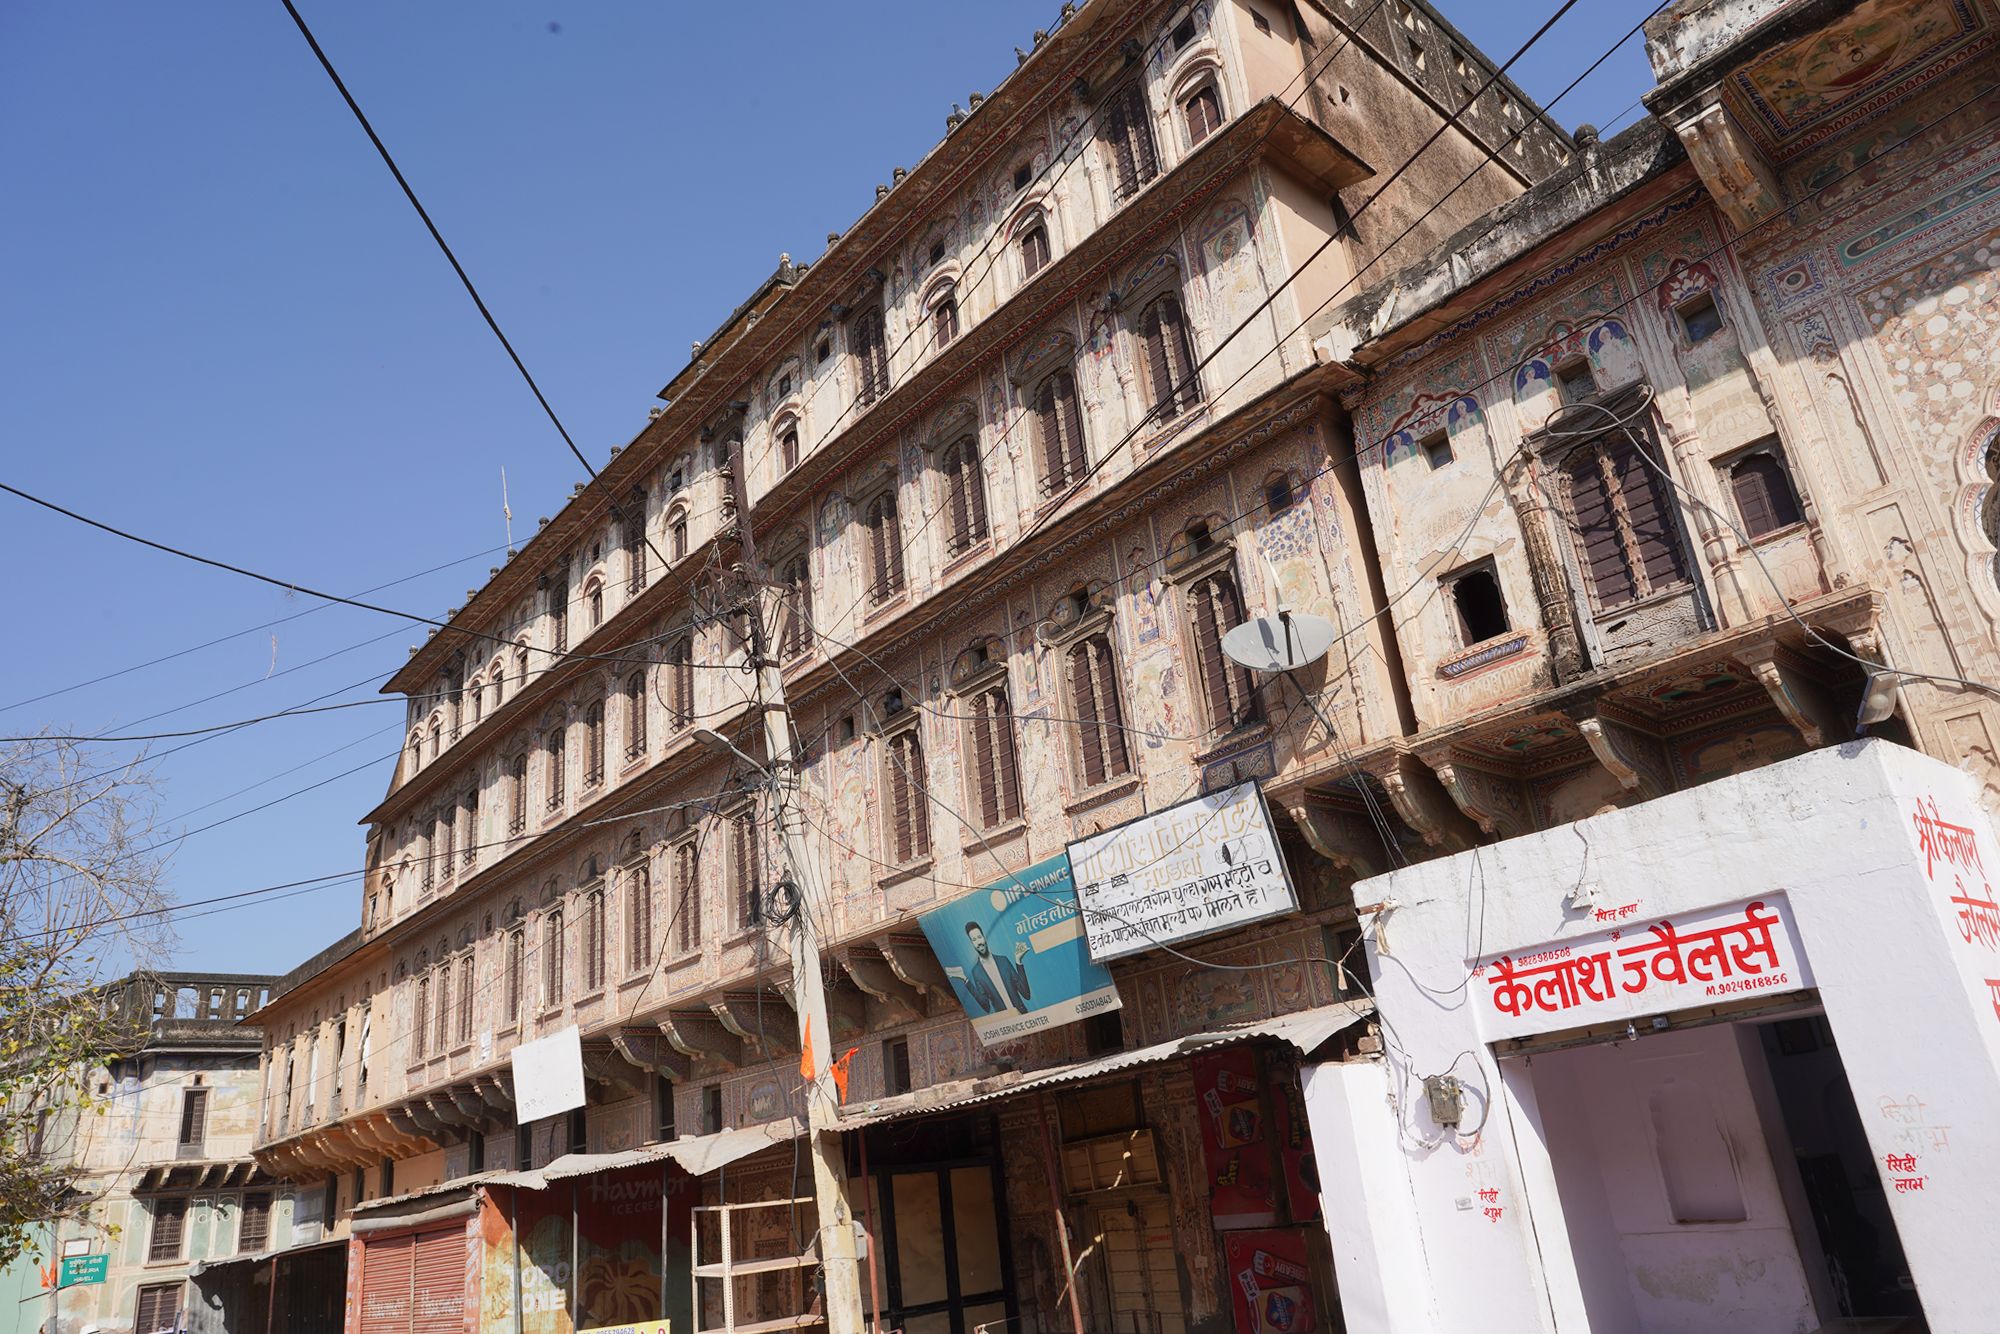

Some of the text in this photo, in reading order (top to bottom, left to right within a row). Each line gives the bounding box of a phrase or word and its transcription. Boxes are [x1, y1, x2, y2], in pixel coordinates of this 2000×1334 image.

[1029, 866, 1071, 892] FINANCE
[1015, 912, 1049, 935] गोल्ड
[1488, 901, 1780, 1018] कैलाश ज्वैलर्स
[983, 1027, 1001, 1041] JOSHI
[1000, 1022, 1025, 1037] SERVICE
[1025, 1015, 1050, 1031] CENTER
[585, 1174, 690, 1204] Havmor
